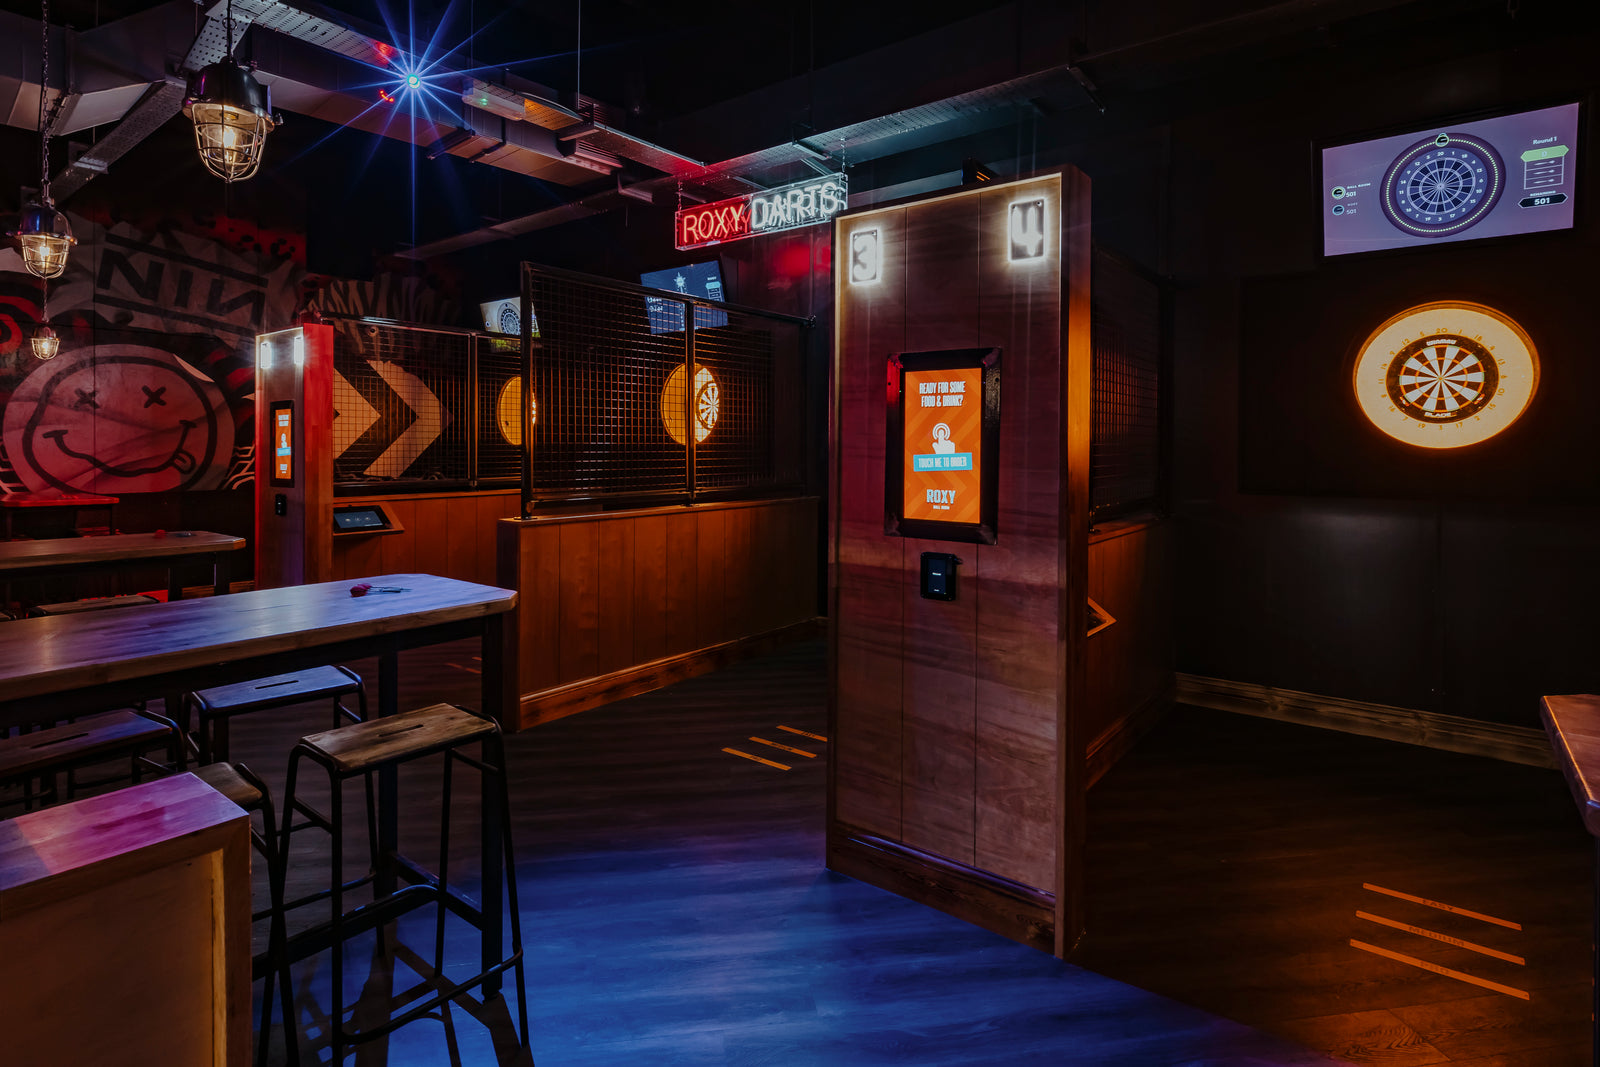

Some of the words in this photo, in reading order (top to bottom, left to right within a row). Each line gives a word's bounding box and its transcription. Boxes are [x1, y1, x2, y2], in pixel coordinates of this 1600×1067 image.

[1533, 137, 1553, 145] Round
[683, 203, 744, 243] ROXY
[751, 181, 840, 229] DARTS
[1012, 205, 1044, 257] 4
[852, 233, 878, 281] 3
[919, 382, 937, 394] READY
[938, 382, 949, 394] FOR
[950, 381, 966, 393] SOME
[921, 395, 936, 407] FOOD
[936, 395, 942, 407] &
[942, 394, 964, 407] DRINK?
[926, 489, 956, 504] ROXY
[1422, 898, 1453, 912] EASY
[1408, 926, 1465, 947] MEDIUM
